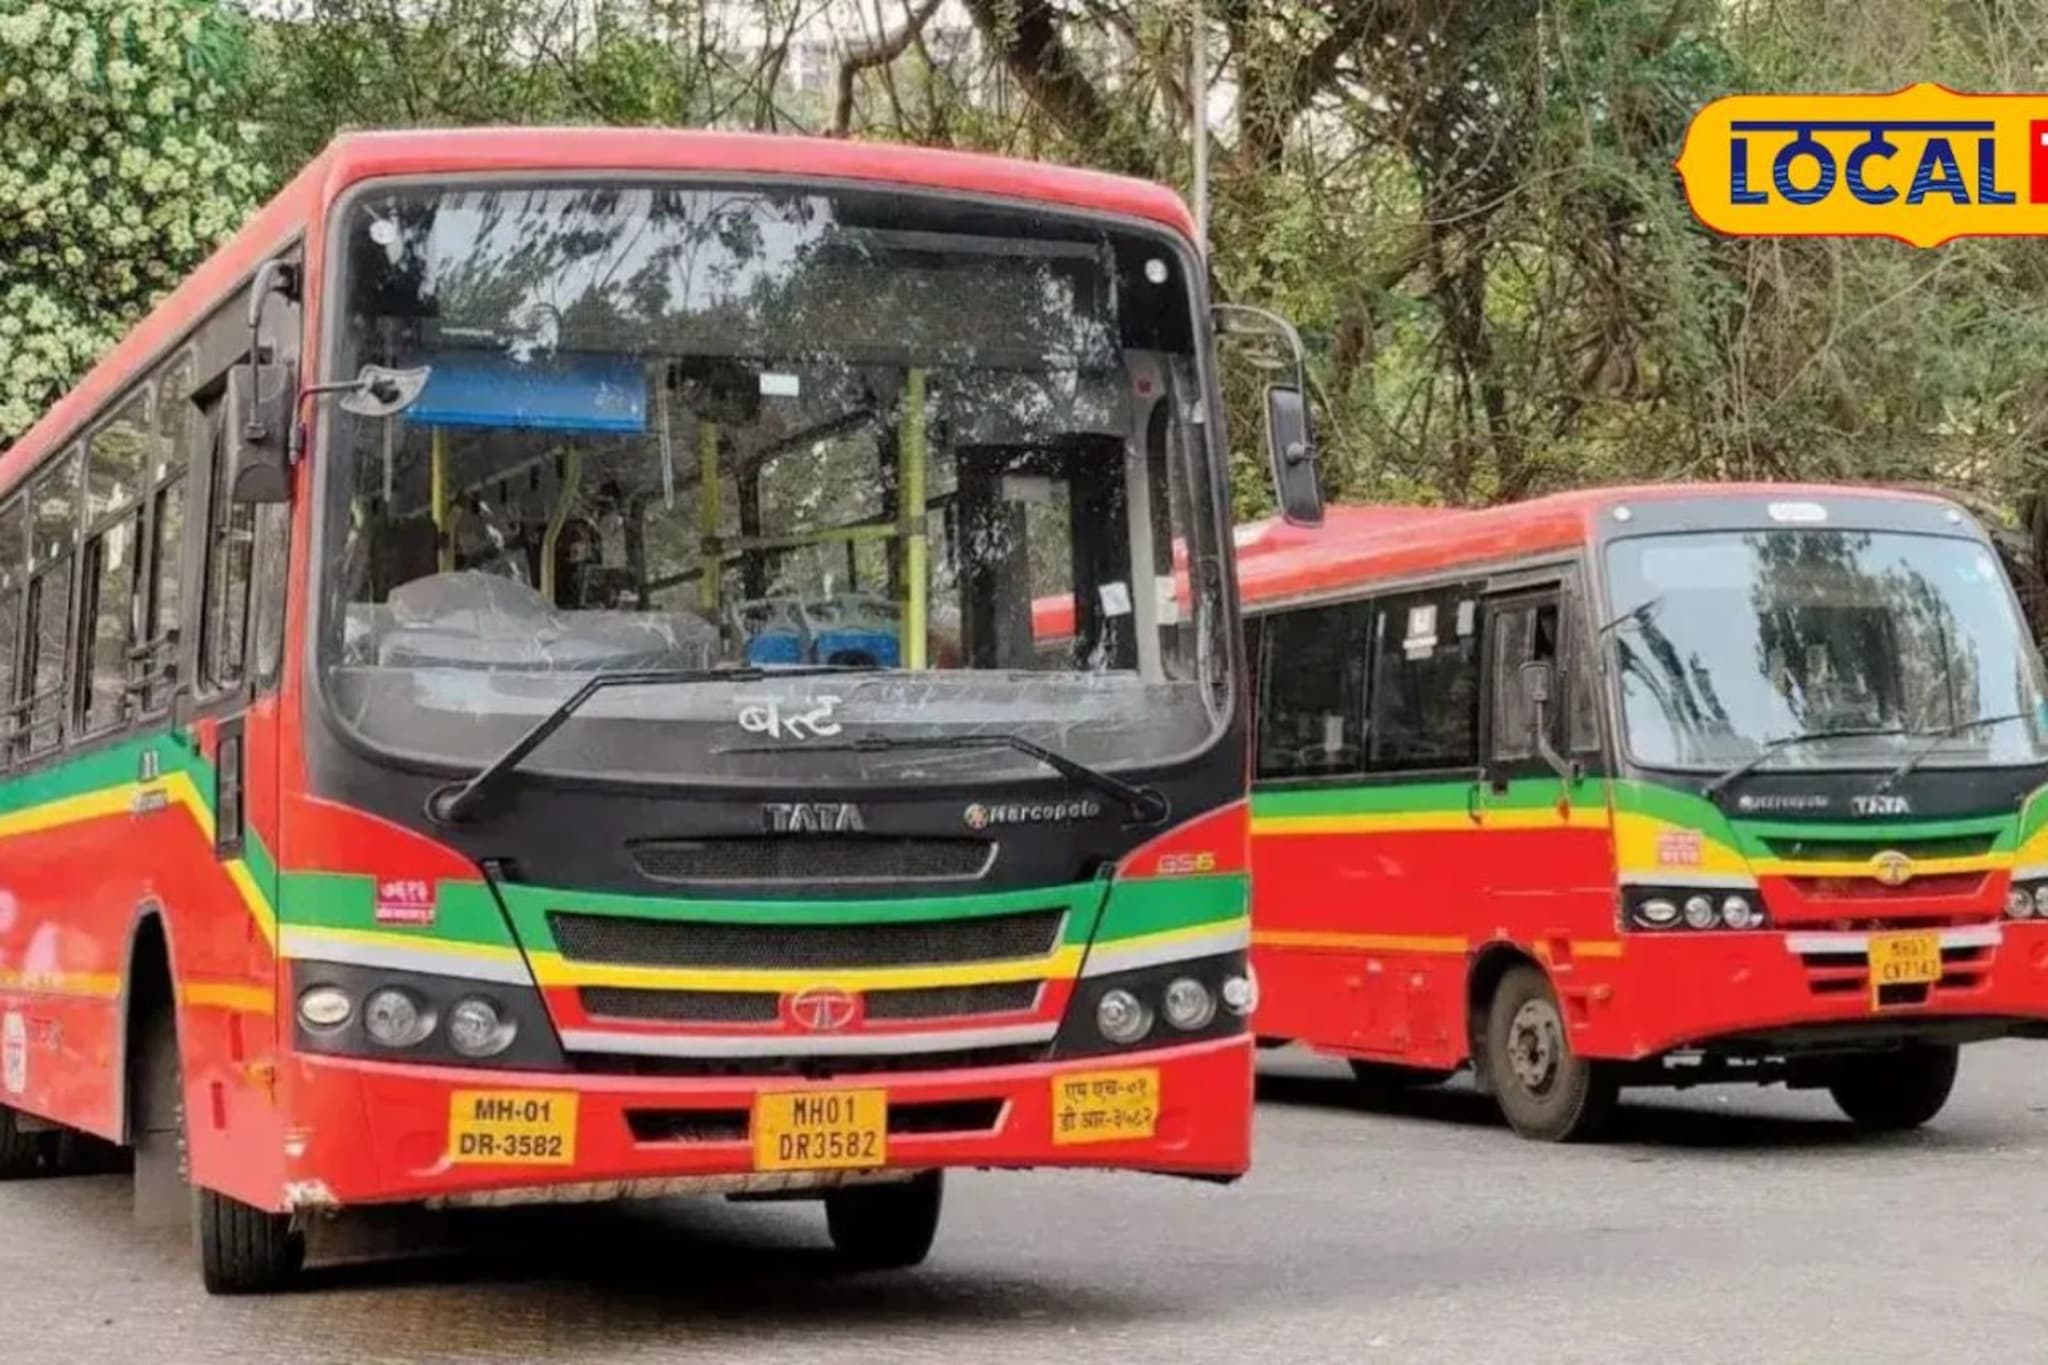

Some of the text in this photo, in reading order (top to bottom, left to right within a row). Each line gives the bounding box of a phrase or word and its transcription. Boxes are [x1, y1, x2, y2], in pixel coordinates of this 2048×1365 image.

[766, 802, 865, 832] TATA
[1852, 796, 1911, 814] TATA
[474, 1098, 550, 1122] MH-01
[793, 1096, 855, 1125] MH01
[460, 1132, 562, 1157] DR-3582
[779, 1130, 876, 1160] DR3582
